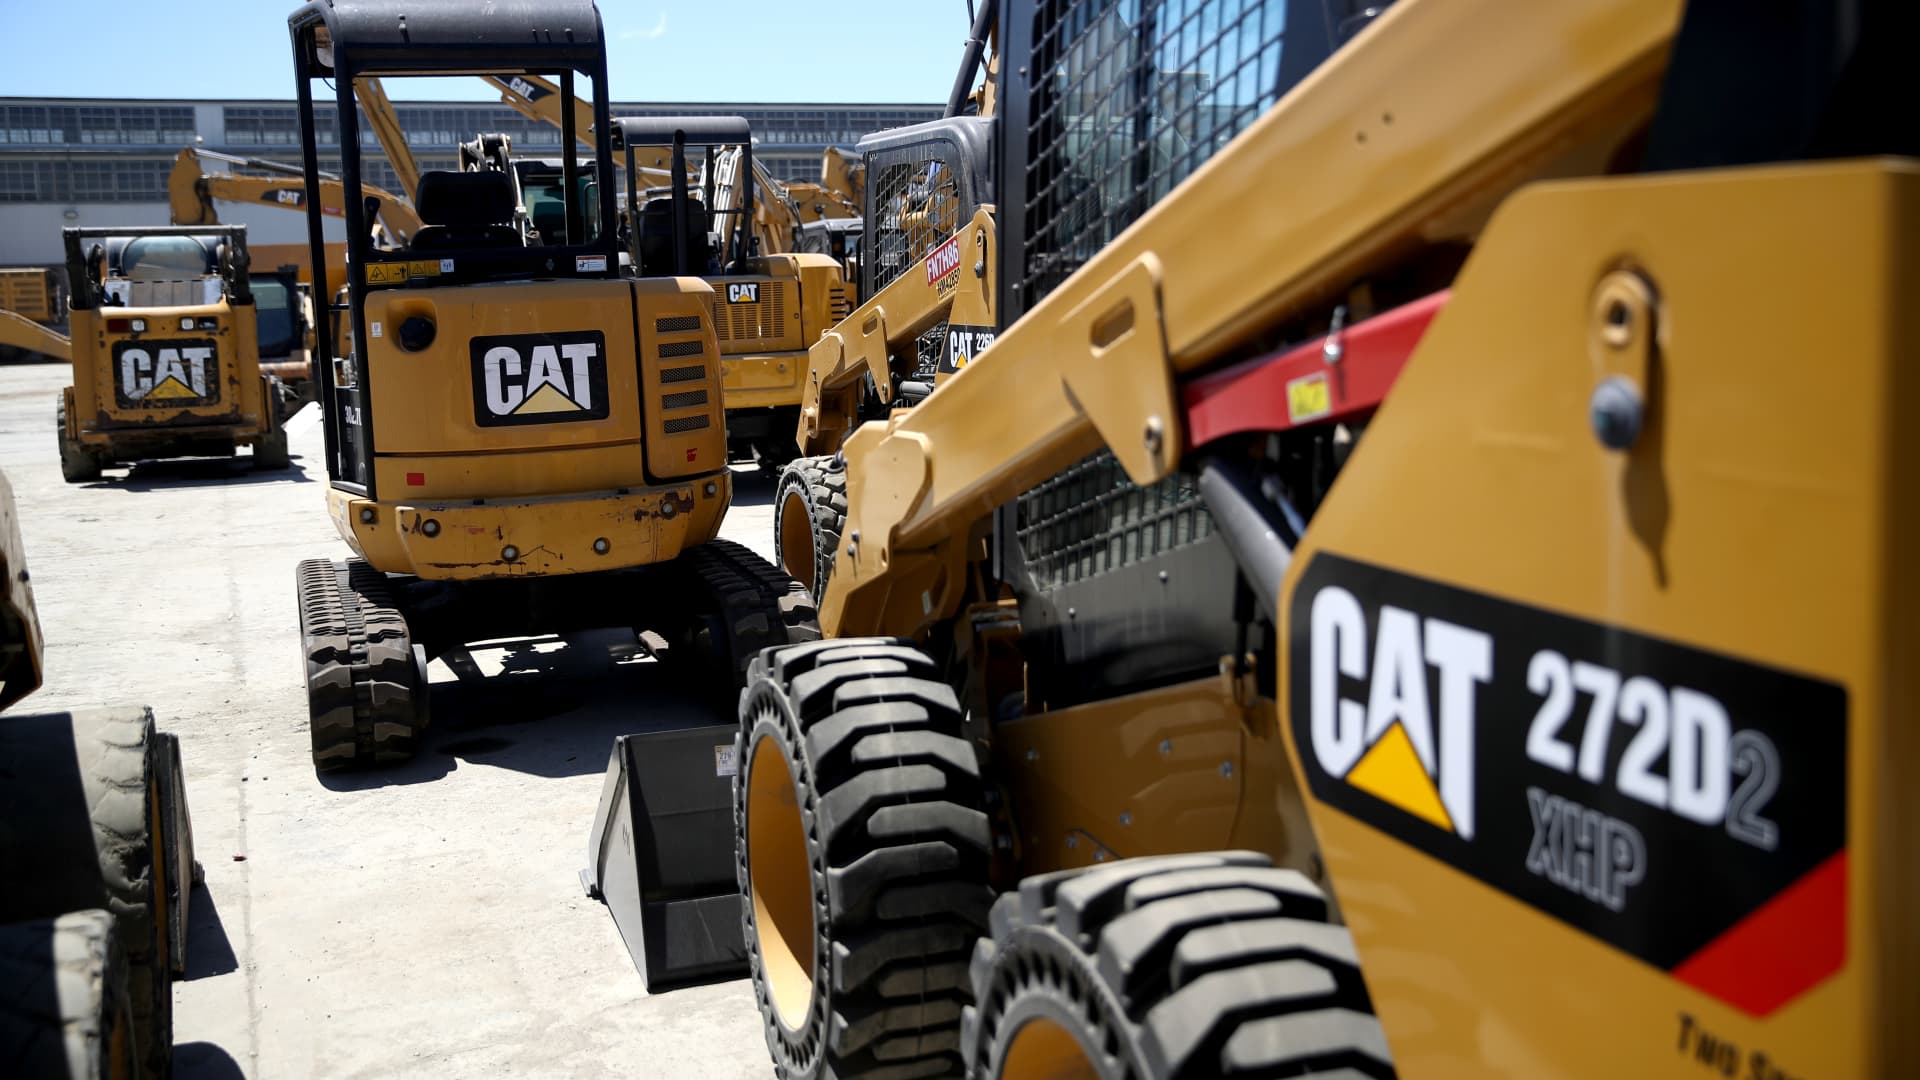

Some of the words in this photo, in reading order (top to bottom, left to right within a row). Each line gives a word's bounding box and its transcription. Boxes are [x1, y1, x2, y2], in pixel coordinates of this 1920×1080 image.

[510, 76, 535, 99] CAT
[277, 189, 301, 206] CAT
[926, 240, 959, 283] FN7H86
[729, 284, 758, 303] CAT
[950, 330, 973, 368] CAT
[121, 347, 212, 400] CAT
[483, 341, 598, 418] CAT
[1309, 583, 1494, 842] CAT
[1524, 786, 1648, 913] XHP
